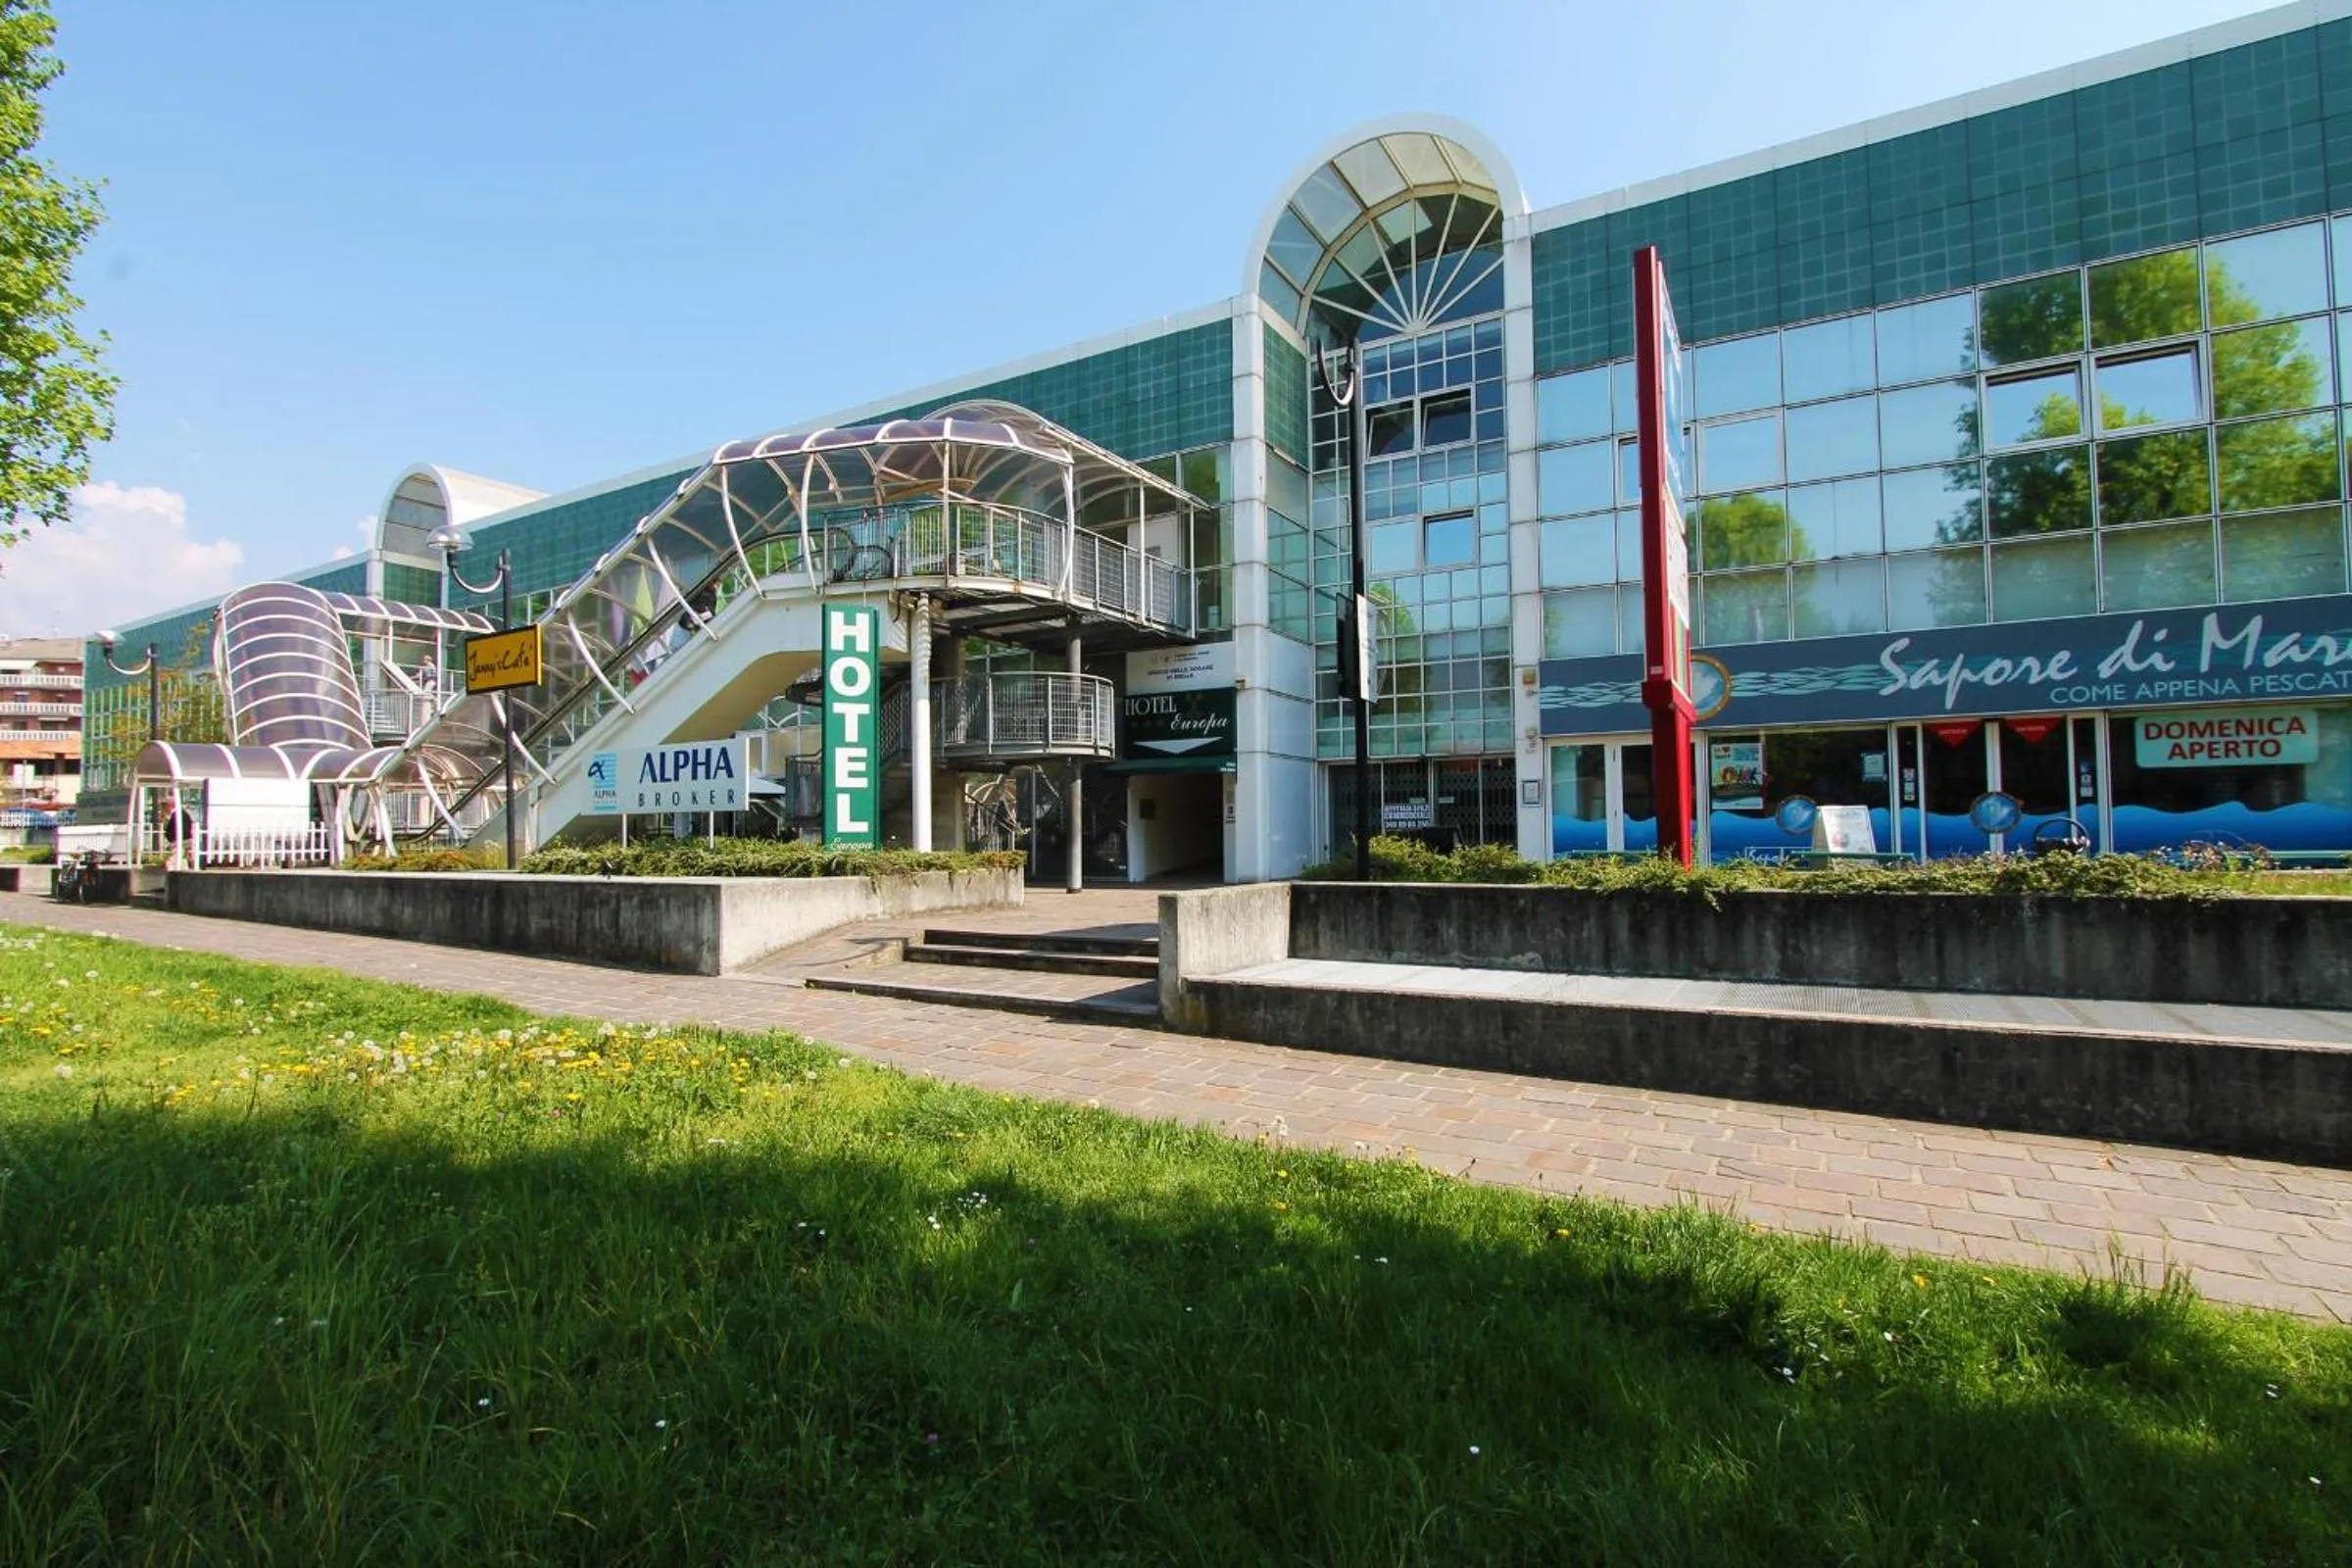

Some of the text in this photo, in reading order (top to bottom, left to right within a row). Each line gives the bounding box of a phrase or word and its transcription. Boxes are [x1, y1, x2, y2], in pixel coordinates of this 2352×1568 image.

[1879, 637, 2078, 710] Sapore
[2098, 619, 2175, 679] di
[2050, 684, 2126, 704] COME
[2134, 678, 2240, 701] APPENA
[1124, 695, 1177, 716] HOTEL
[829, 611, 871, 833] HOTEL
[1170, 712, 1229, 735] Europa
[2144, 716, 2305, 740] DOMENICA
[2168, 739, 2281, 760] APERTO
[639, 746, 734, 783] ALPHA
[639, 789, 735, 808] BROKER
